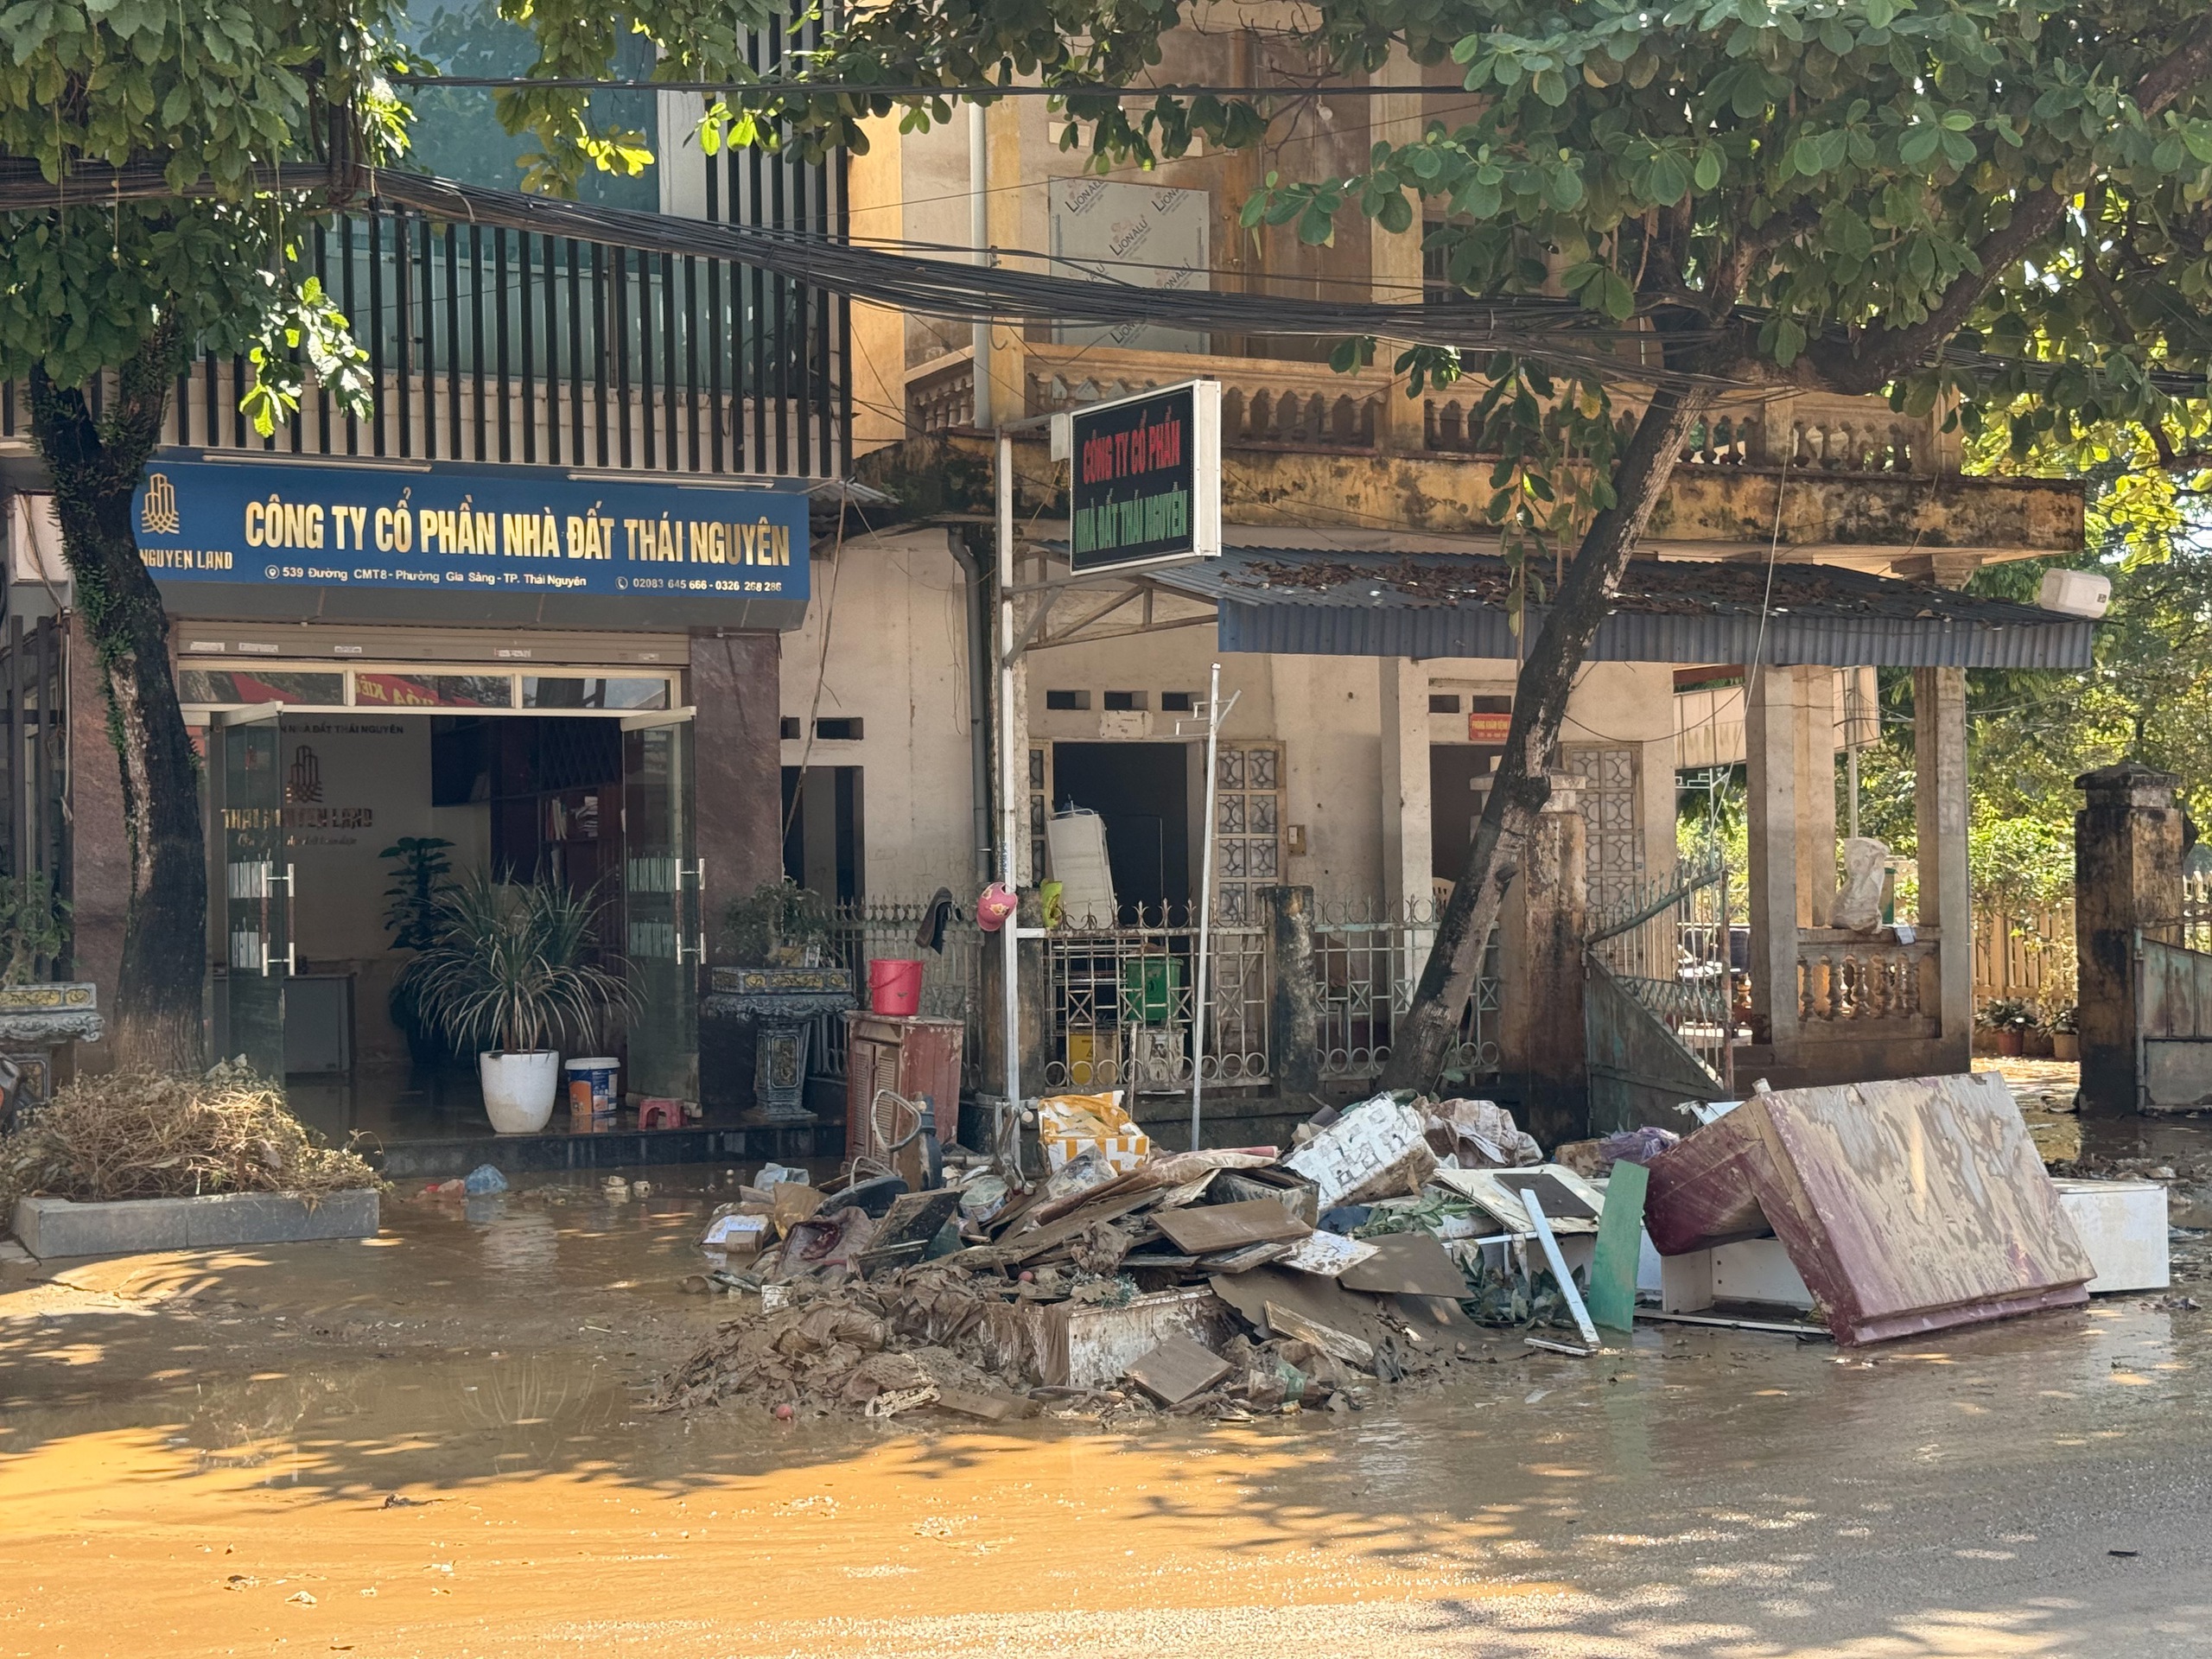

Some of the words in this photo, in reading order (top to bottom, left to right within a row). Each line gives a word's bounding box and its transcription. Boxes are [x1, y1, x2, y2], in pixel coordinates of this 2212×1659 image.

[1109, 219, 1147, 256] LIONALU
[1084, 429, 1113, 485] CÔNG
[1115, 432, 1128, 478] TY
[245, 494, 324, 549] CÔNG
[331, 505, 367, 550] TY
[375, 486, 412, 553] CỔ
[420, 494, 496, 555] PHẦN
[503, 506, 561, 557] NHÀ
[566, 500, 614, 560] ĐẤT
[624, 512, 683, 562] THÁI
[690, 517, 790, 566] NGUYÊN
[138, 549, 193, 570] NGUYEN
[197, 550, 233, 570] LAND
[283, 567, 304, 577] 539
[308, 567, 348, 582] Đường
[353, 569, 387, 580] CMT8
[396, 569, 440, 583] Phường
[446, 571, 464, 582] Gia
[504, 573, 520, 583] TP.
[524, 574, 545, 584] Thái
[547, 575, 587, 588] Nguyên
[632, 578, 664, 588] 02083
[668, 579, 687, 589] 645
[689, 580, 708, 590] 666
